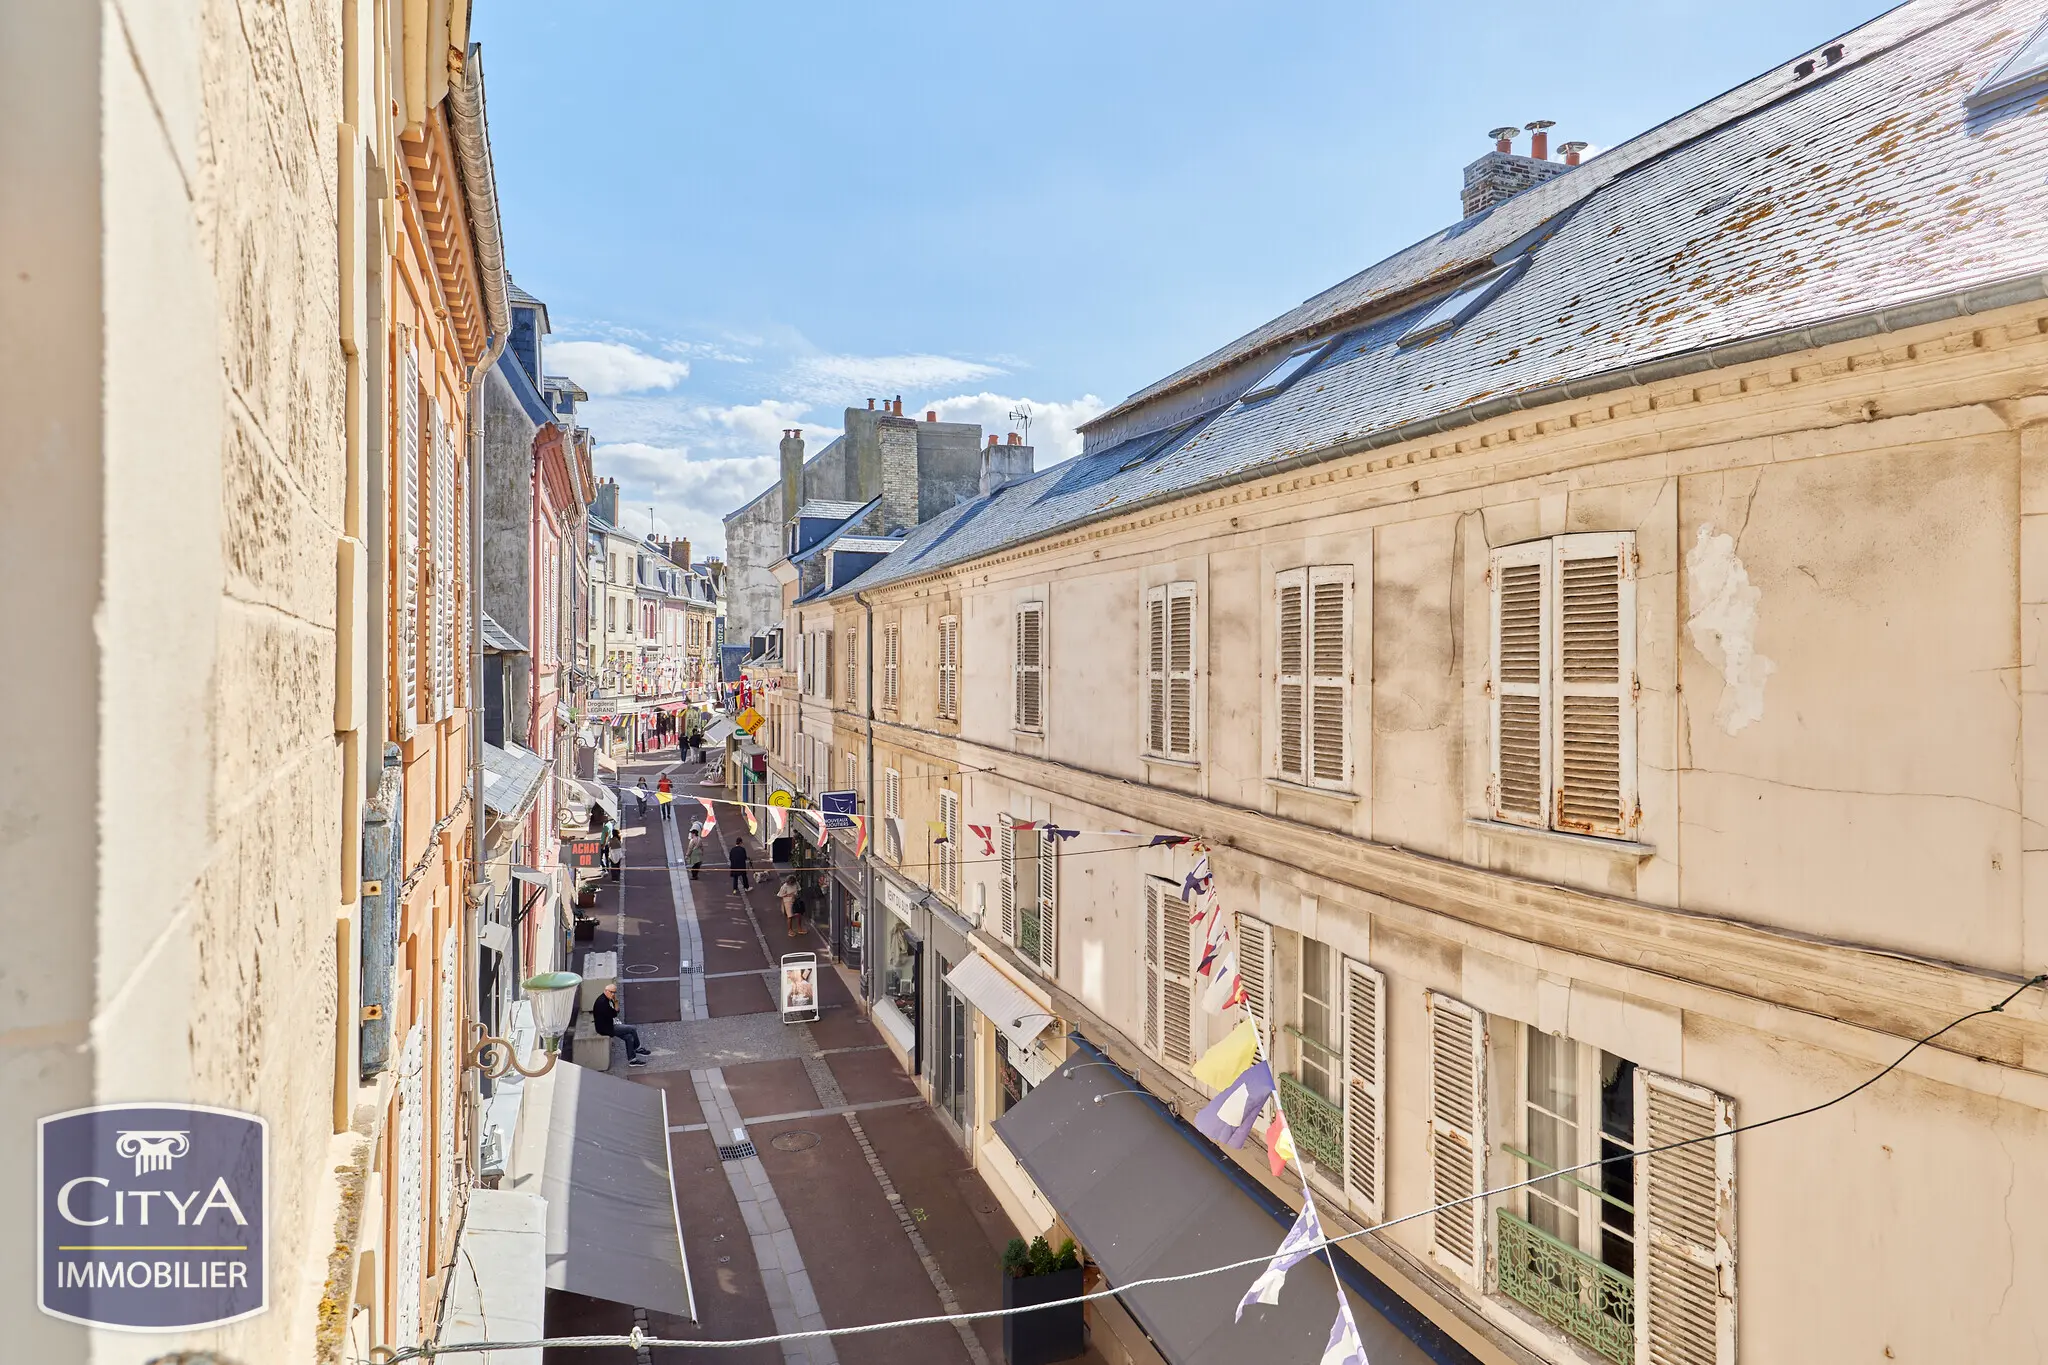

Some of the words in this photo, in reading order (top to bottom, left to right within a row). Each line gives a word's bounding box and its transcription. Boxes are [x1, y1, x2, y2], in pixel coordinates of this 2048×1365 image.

[748, 718, 763, 733] PRESSE
[572, 843, 599, 854] ACHAT
[580, 855, 591, 865] OR
